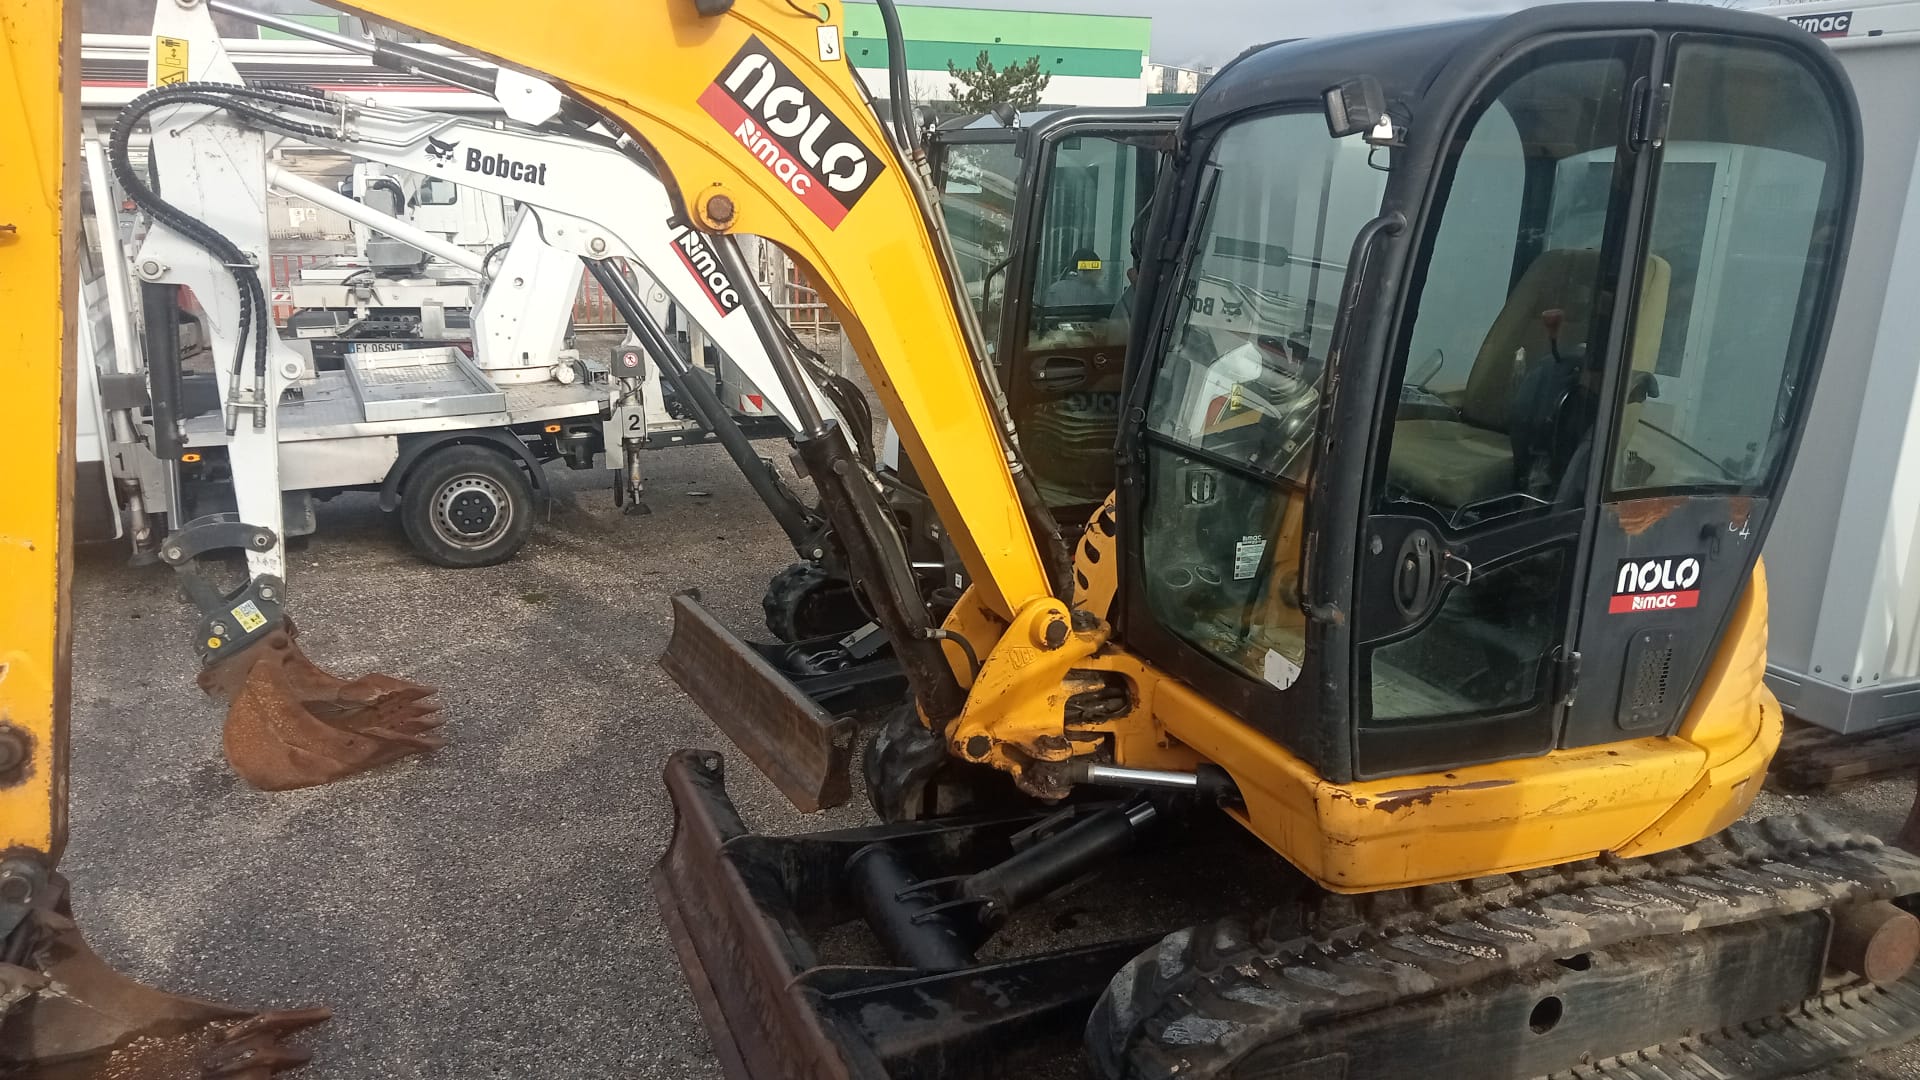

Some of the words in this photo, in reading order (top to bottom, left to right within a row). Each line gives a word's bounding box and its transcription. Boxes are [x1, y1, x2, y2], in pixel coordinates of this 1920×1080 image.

[465, 147, 547, 185] Bobcat
[734, 118, 811, 195] Rimac
[679, 230, 739, 308] Rimac
[628, 414, 641, 431] 2
[115, 452, 125, 471] 1
[1632, 594, 1678, 610] Rimac
